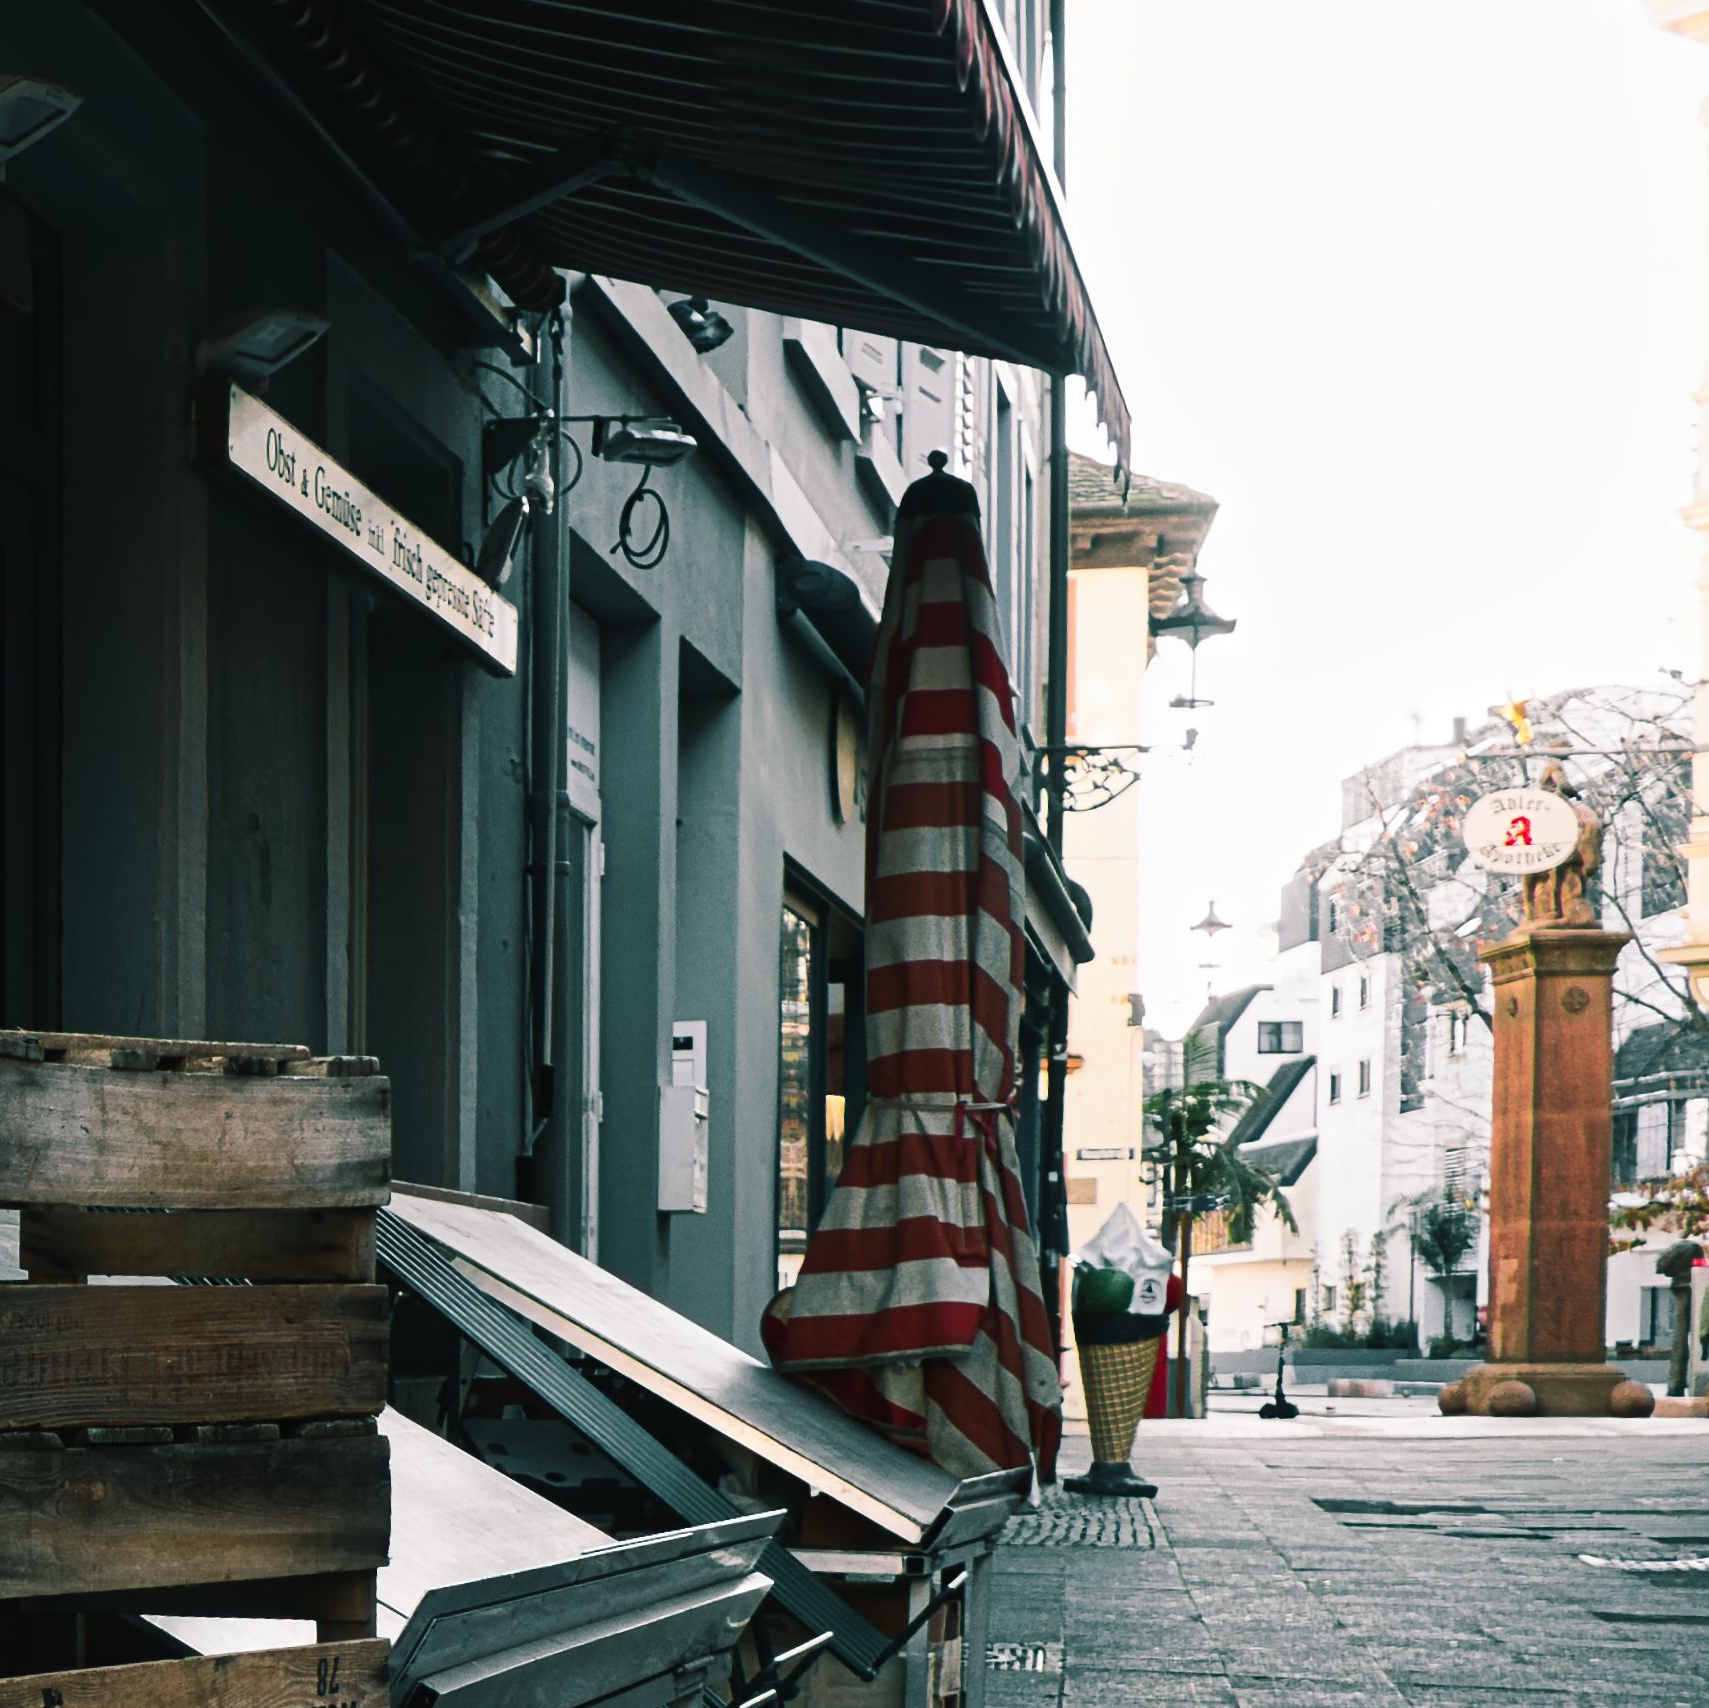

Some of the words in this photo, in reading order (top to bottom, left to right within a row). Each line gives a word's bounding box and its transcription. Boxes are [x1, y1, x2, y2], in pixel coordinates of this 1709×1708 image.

[267, 427, 296, 487] Obst
[301, 468, 309, 498] &
[315, 465, 361, 537] Gemüse
[392, 526, 422, 584] frisch
[316, 1656, 340, 1697] 78
